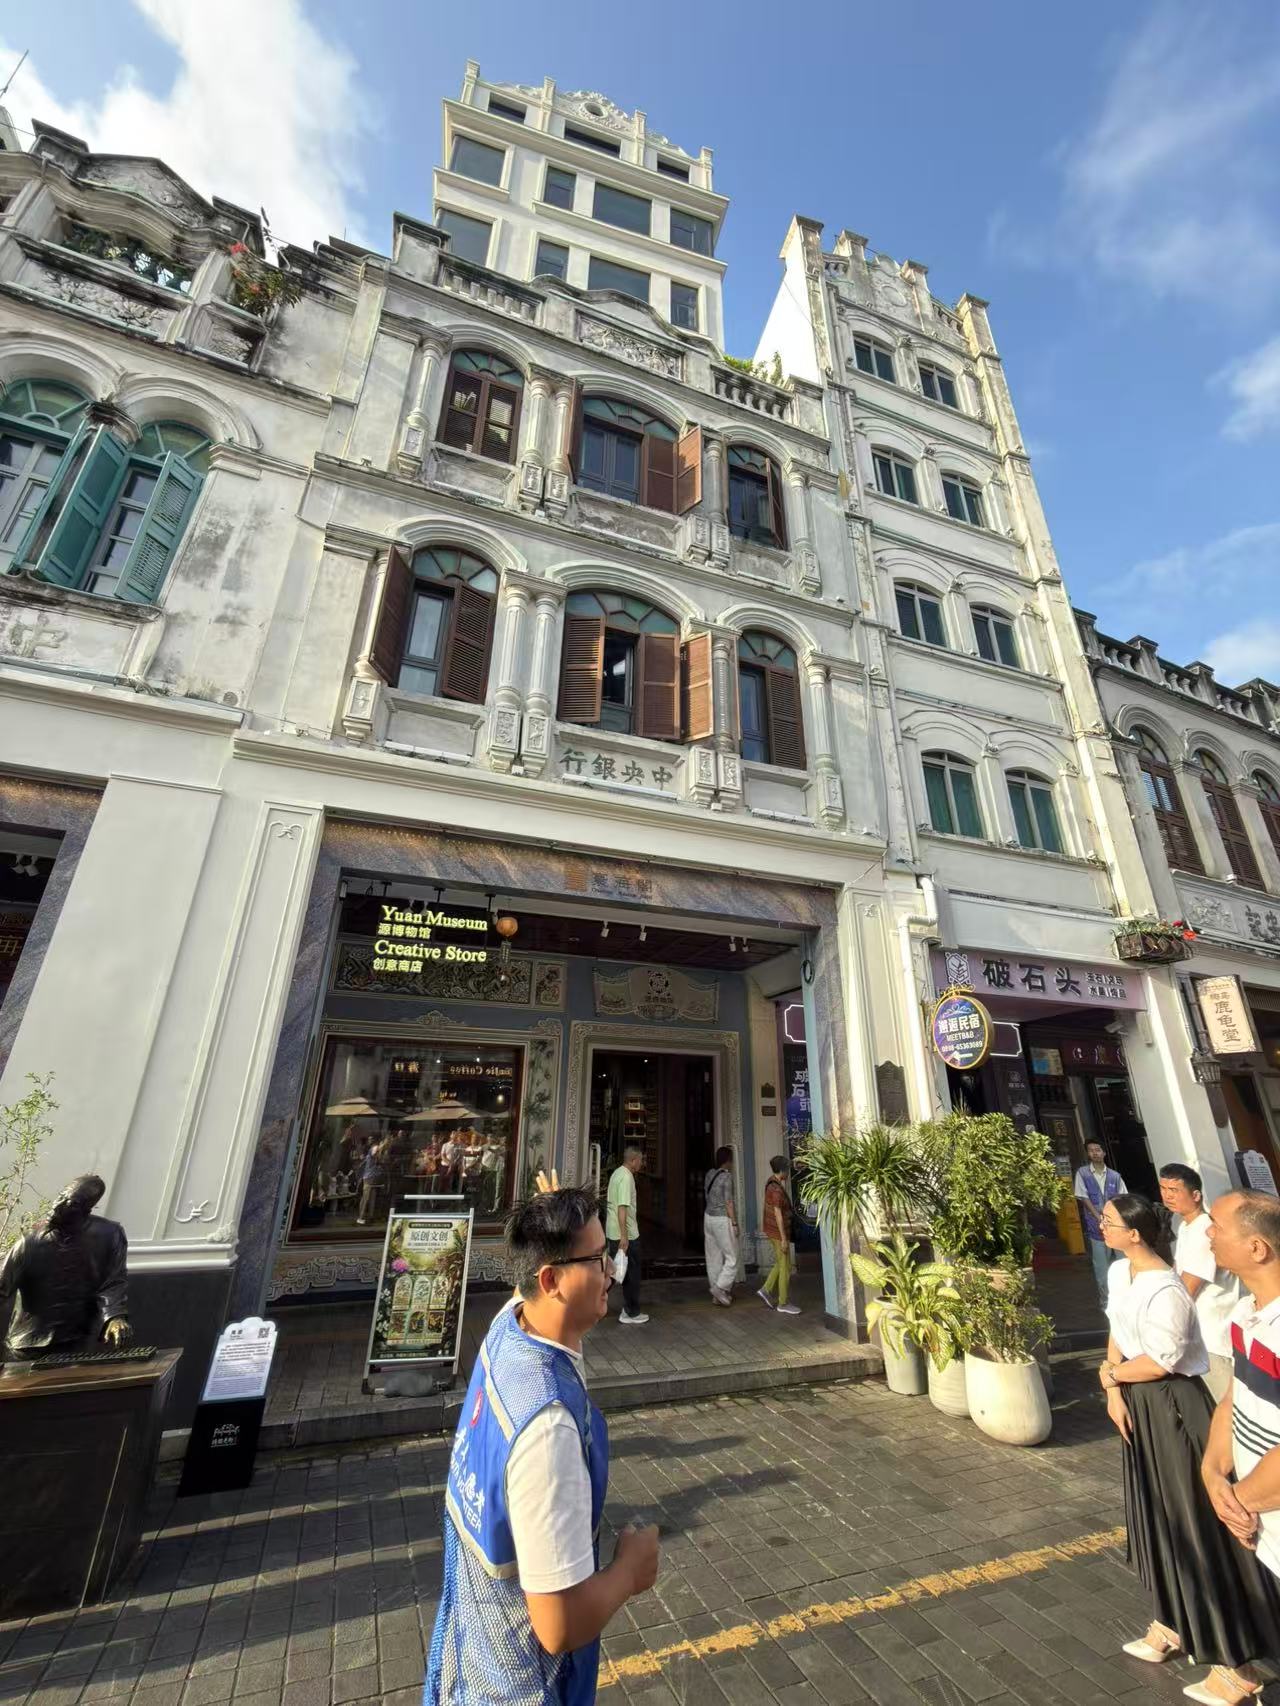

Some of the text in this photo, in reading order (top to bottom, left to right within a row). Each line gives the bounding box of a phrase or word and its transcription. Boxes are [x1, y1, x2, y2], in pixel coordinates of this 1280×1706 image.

[381, 905, 488, 931] Yuan Museum
[377, 922, 432, 940] 源博物馆
[374, 939, 441, 959] Creative
[445, 946, 487, 962] Store
[372, 957, 423, 973] 创意商店
[982, 957, 1082, 998] 破石头
[938, 1013, 981, 1034] 邂逅民宿
[1215, 1000, 1241, 1042] 鹿龟堂
[410, 1230, 448, 1242] 原创文创
